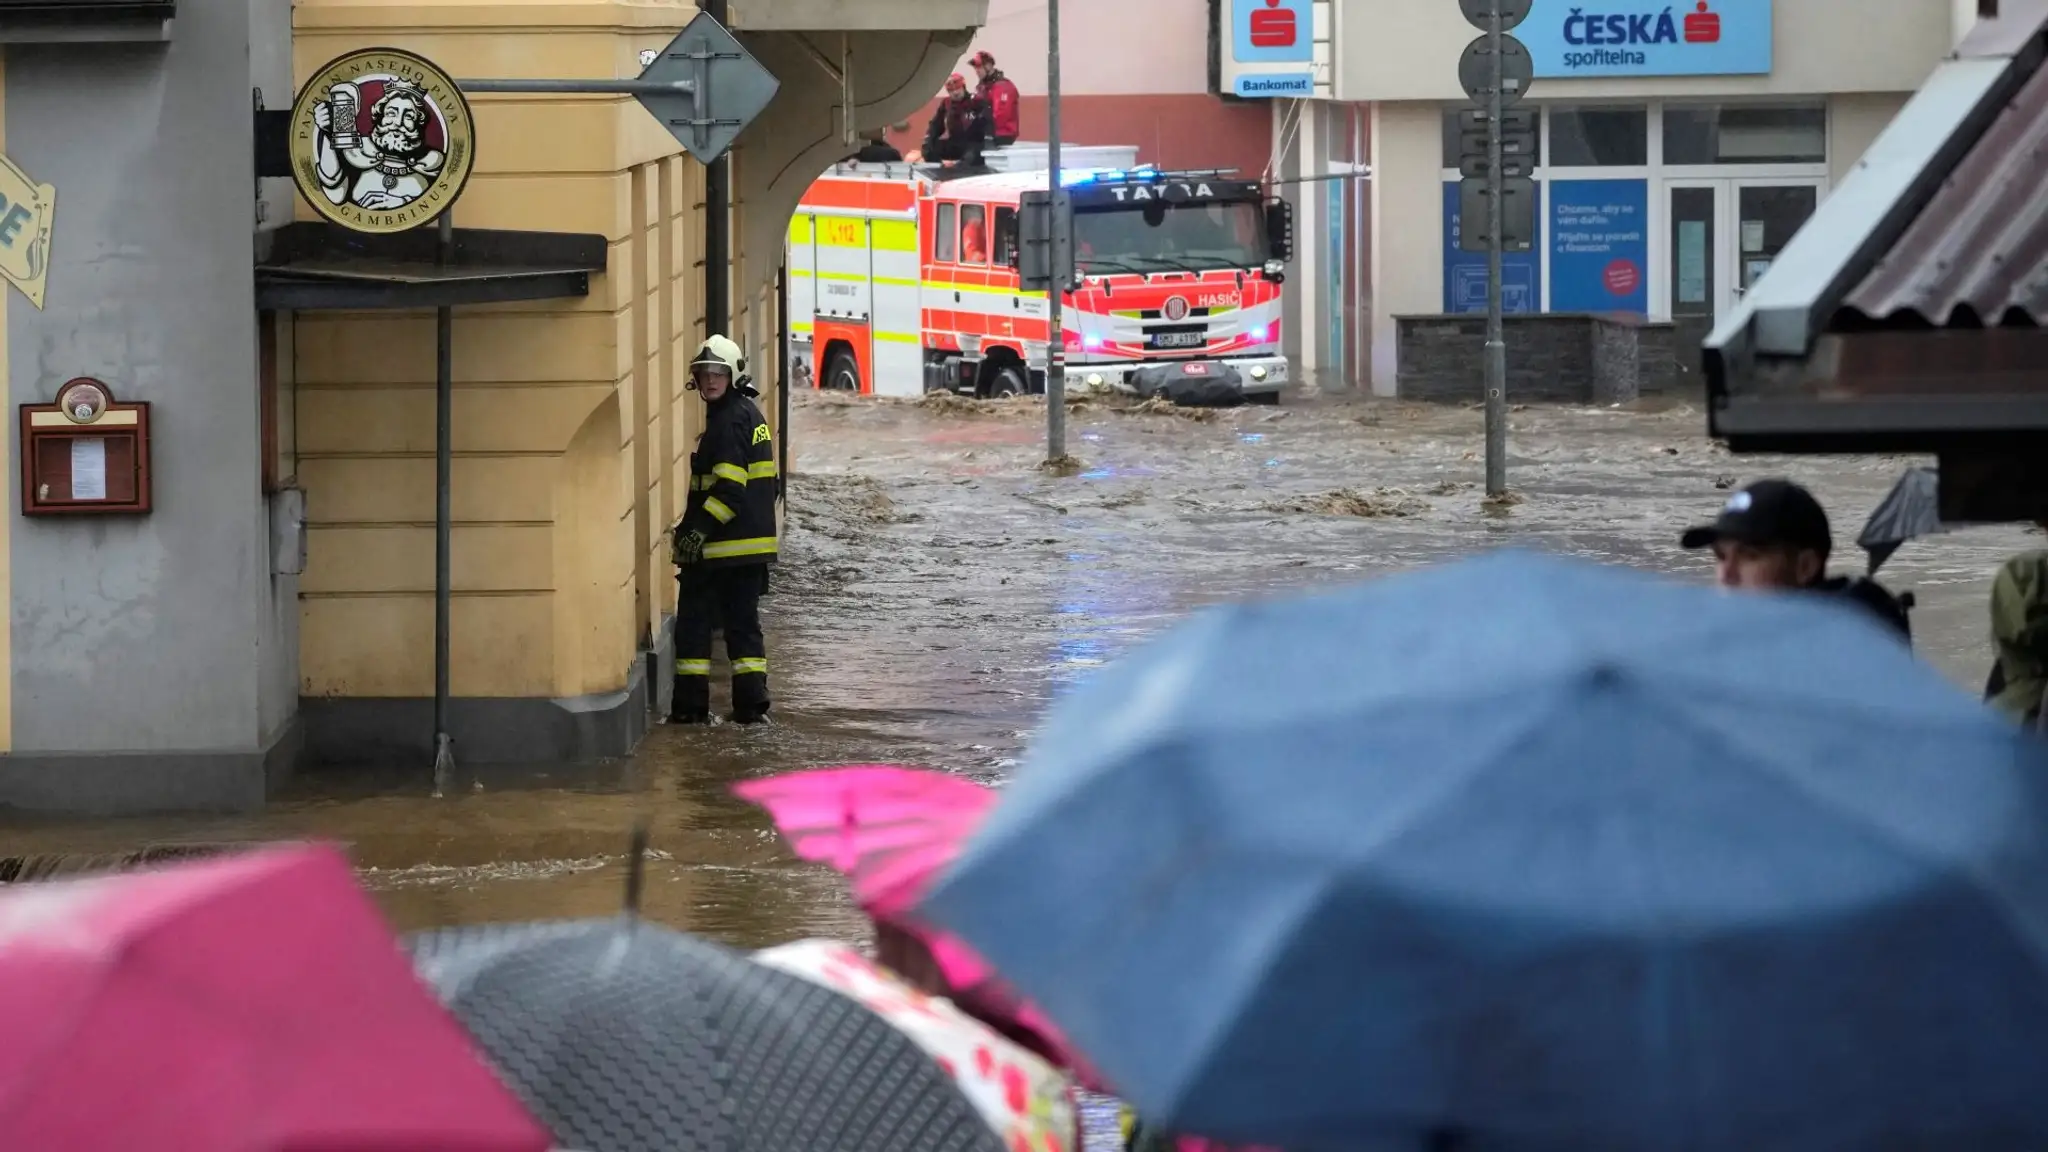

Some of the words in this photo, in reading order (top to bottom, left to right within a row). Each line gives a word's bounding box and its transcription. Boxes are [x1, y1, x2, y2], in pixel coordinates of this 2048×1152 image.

[1563, 7, 1678, 45] ČESKÁ
[1563, 49, 1645, 69] spořitelna
[1242, 79, 1307, 92] Bankomat
[430, 84, 460, 124] PIVA
[340, 180, 449, 226] GAMBRINUS
[838, 224, 855, 243] 112
